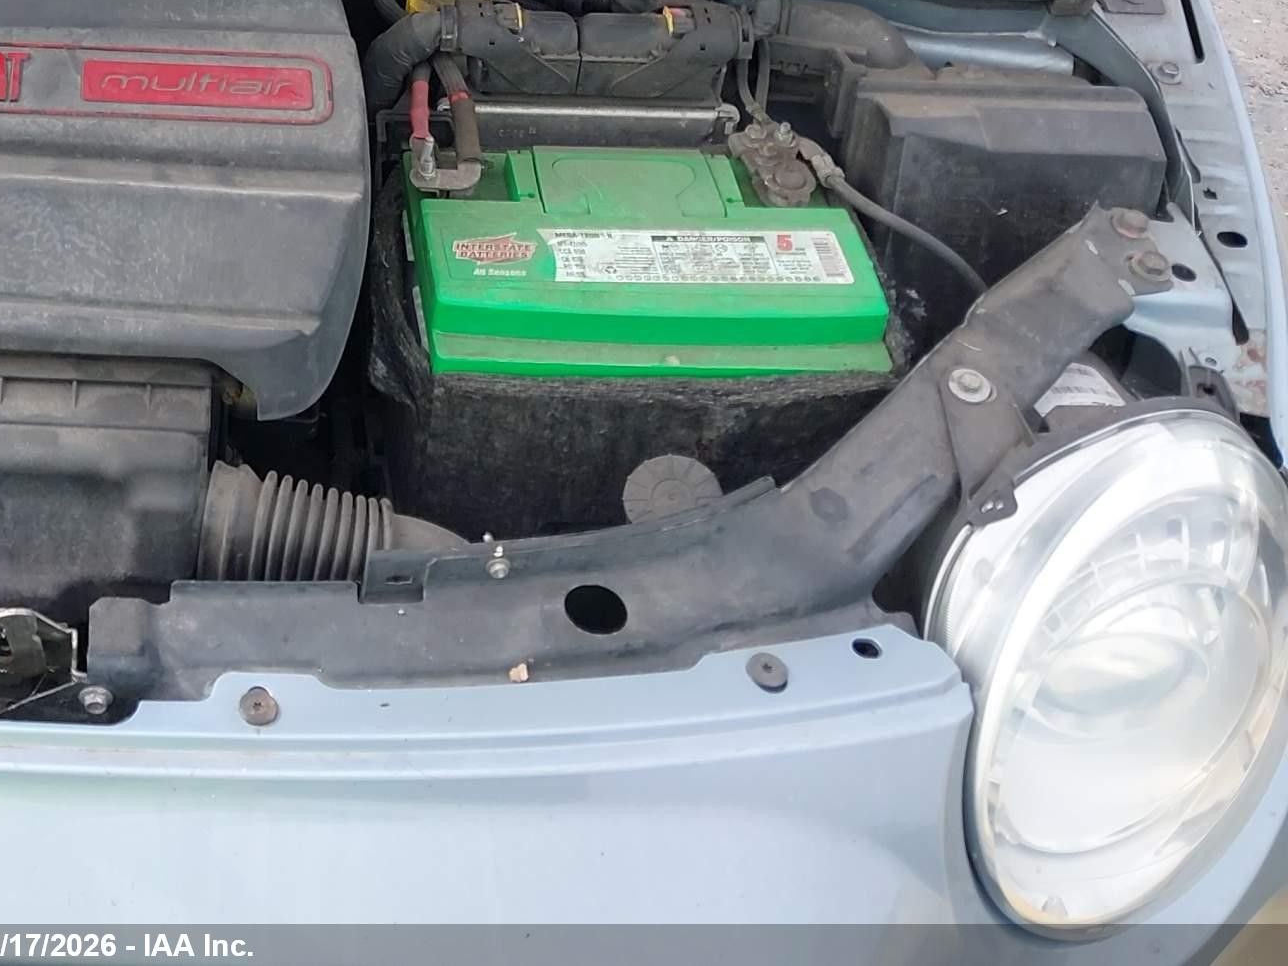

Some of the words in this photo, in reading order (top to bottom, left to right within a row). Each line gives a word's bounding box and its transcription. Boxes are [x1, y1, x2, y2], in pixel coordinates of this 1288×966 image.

[100, 71, 295, 97] multiair
[676, 235, 751, 243] DANGER/POISON
[776, 233, 793, 252] 5
[455, 242, 534, 252] INTERSTATE
[460, 251, 530, 259] BATTERIES
